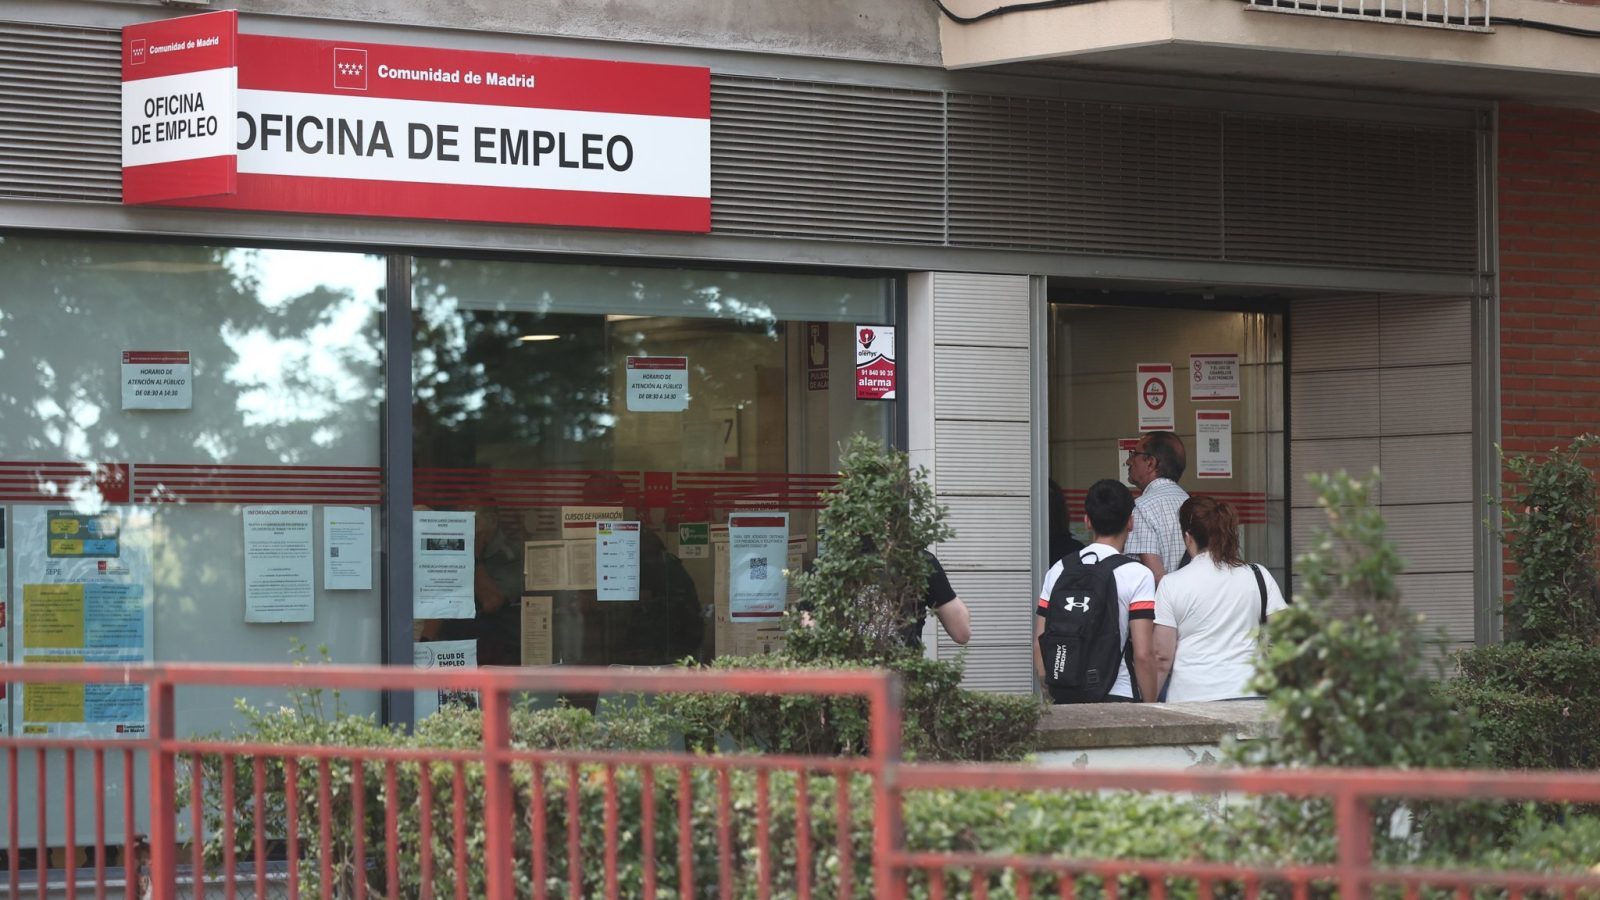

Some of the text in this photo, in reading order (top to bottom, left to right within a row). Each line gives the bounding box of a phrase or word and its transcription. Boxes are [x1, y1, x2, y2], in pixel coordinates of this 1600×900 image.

[149, 36, 220, 54] Comunidad de Madrid
[377, 64, 535, 88] Comunidad de Madrid
[144, 92, 205, 118] OFICINA
[131, 115, 218, 145] DE EMPLEO
[237, 110, 634, 172] OFICINA DE EMPLEO
[859, 377, 891, 387] alarma
[724, 418, 733, 445] 7
[565, 512, 584, 521] CURSOS
[584, 512, 591, 520] DE
[1053, 644, 1062, 680] ARMOUR
[1059, 645, 1067, 673] UNDER
